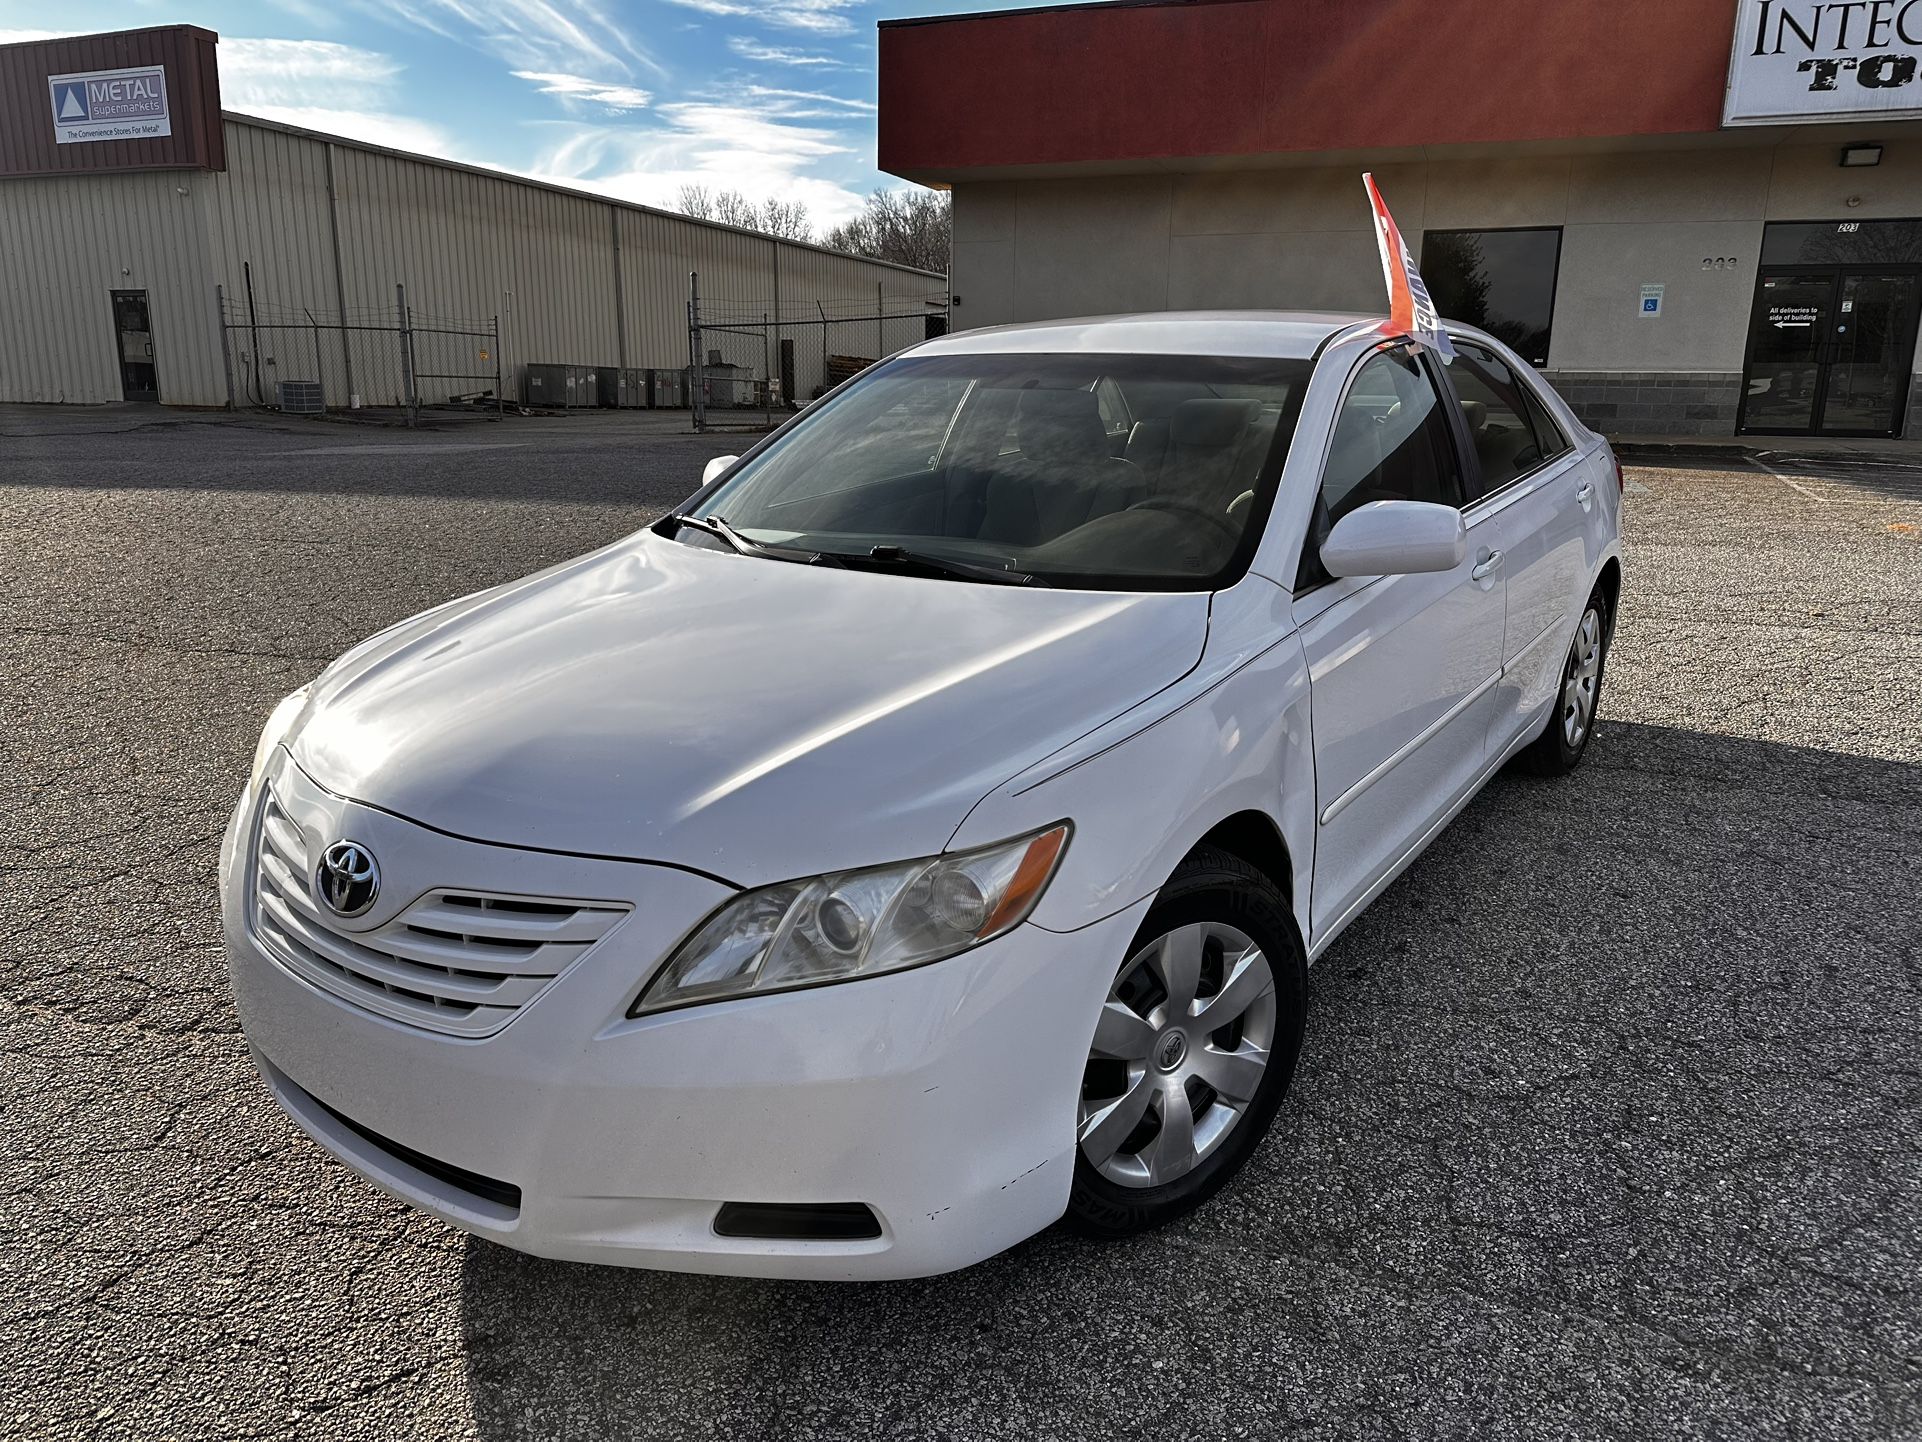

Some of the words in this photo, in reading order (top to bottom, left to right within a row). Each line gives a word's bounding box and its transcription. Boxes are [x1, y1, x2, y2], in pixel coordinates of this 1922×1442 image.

[1796, 54, 1922, 91] TO
[90, 78, 158, 103] METAL
[94, 101, 160, 116] supermarkets
[68, 131, 77, 139] The
[78, 128, 113, 138] Convenience
[114, 127, 132, 136] Stores
[132, 126, 141, 134] For
[1838, 223, 1858, 232] 203
[1701, 257, 1738, 271] 203
[1792, 314, 1817, 322] building
